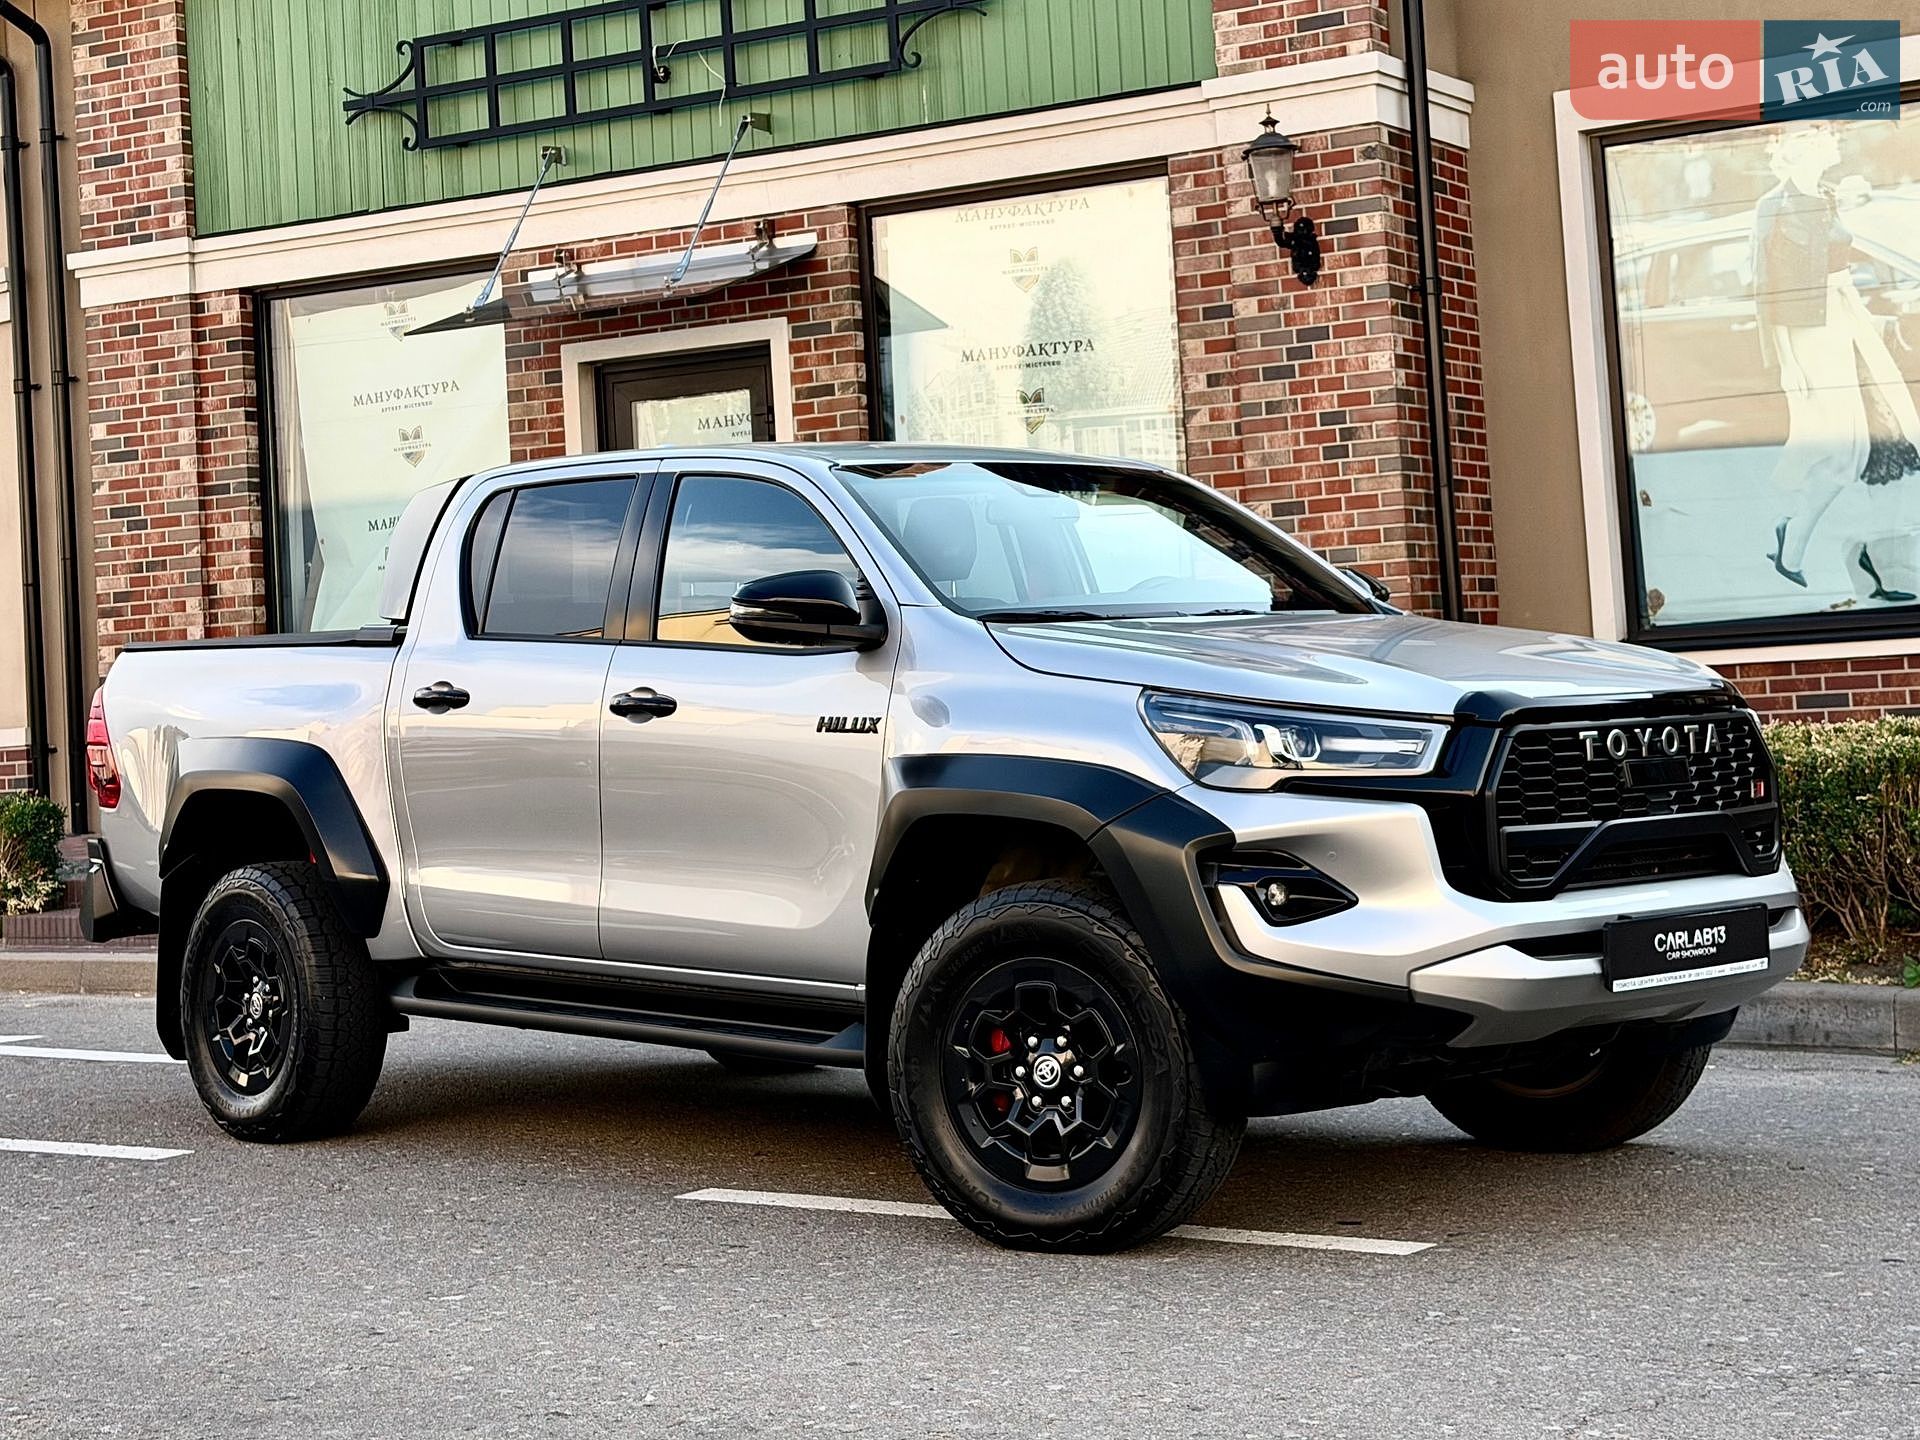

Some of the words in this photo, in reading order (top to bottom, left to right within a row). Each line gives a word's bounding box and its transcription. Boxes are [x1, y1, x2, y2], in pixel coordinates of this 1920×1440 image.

[955, 197, 1090, 223] МАНУФАКТУРА
[960, 337, 1095, 363] МАНУФАКТУРА
[353, 380, 460, 406] МАНУФАКТУРА
[816, 716, 882, 734] HILUX
[1579, 723, 1721, 761] TOYOTA
[1654, 925, 1727, 953] CARLAB13
[1666, 951, 1681, 961] CAR
[1681, 946, 1717, 960] SHOWROOM
